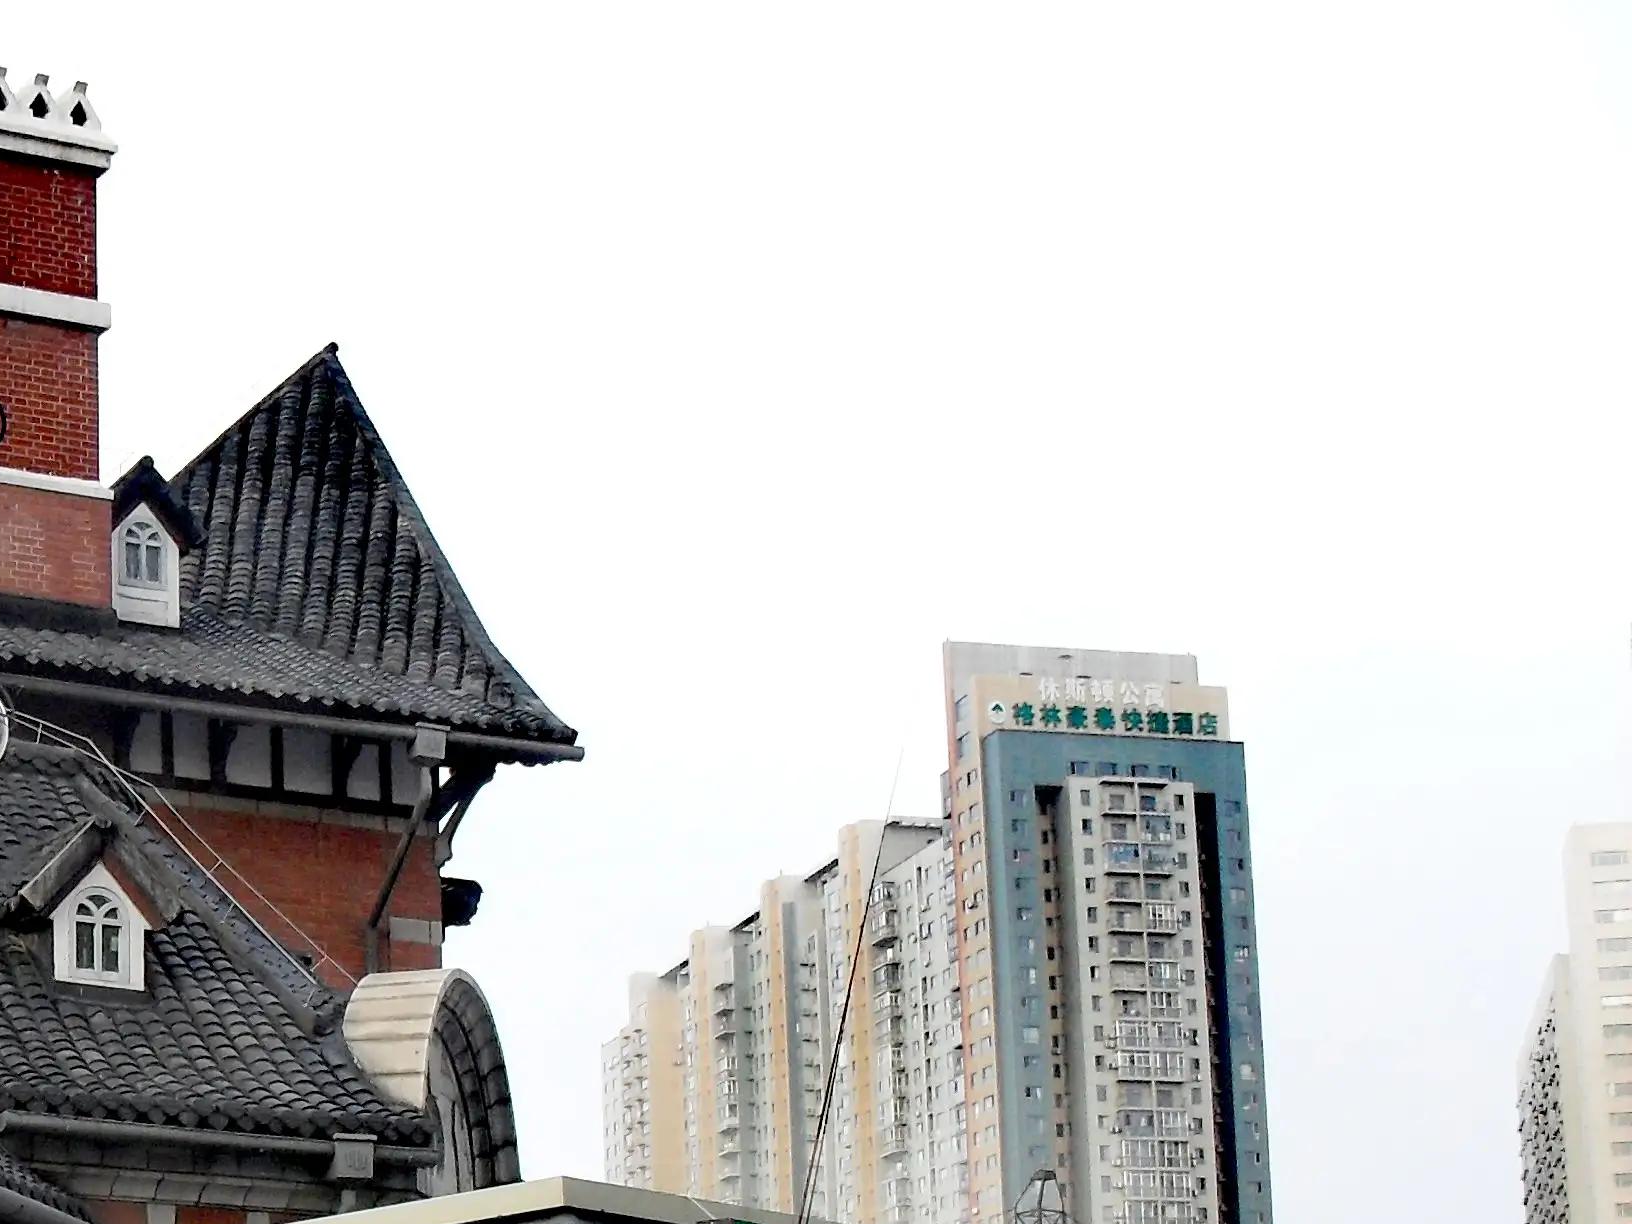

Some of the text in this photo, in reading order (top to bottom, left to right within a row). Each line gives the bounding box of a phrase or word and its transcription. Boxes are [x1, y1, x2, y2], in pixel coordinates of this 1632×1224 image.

[1012, 702, 1218, 736] 格林豪泰快捷酒店
